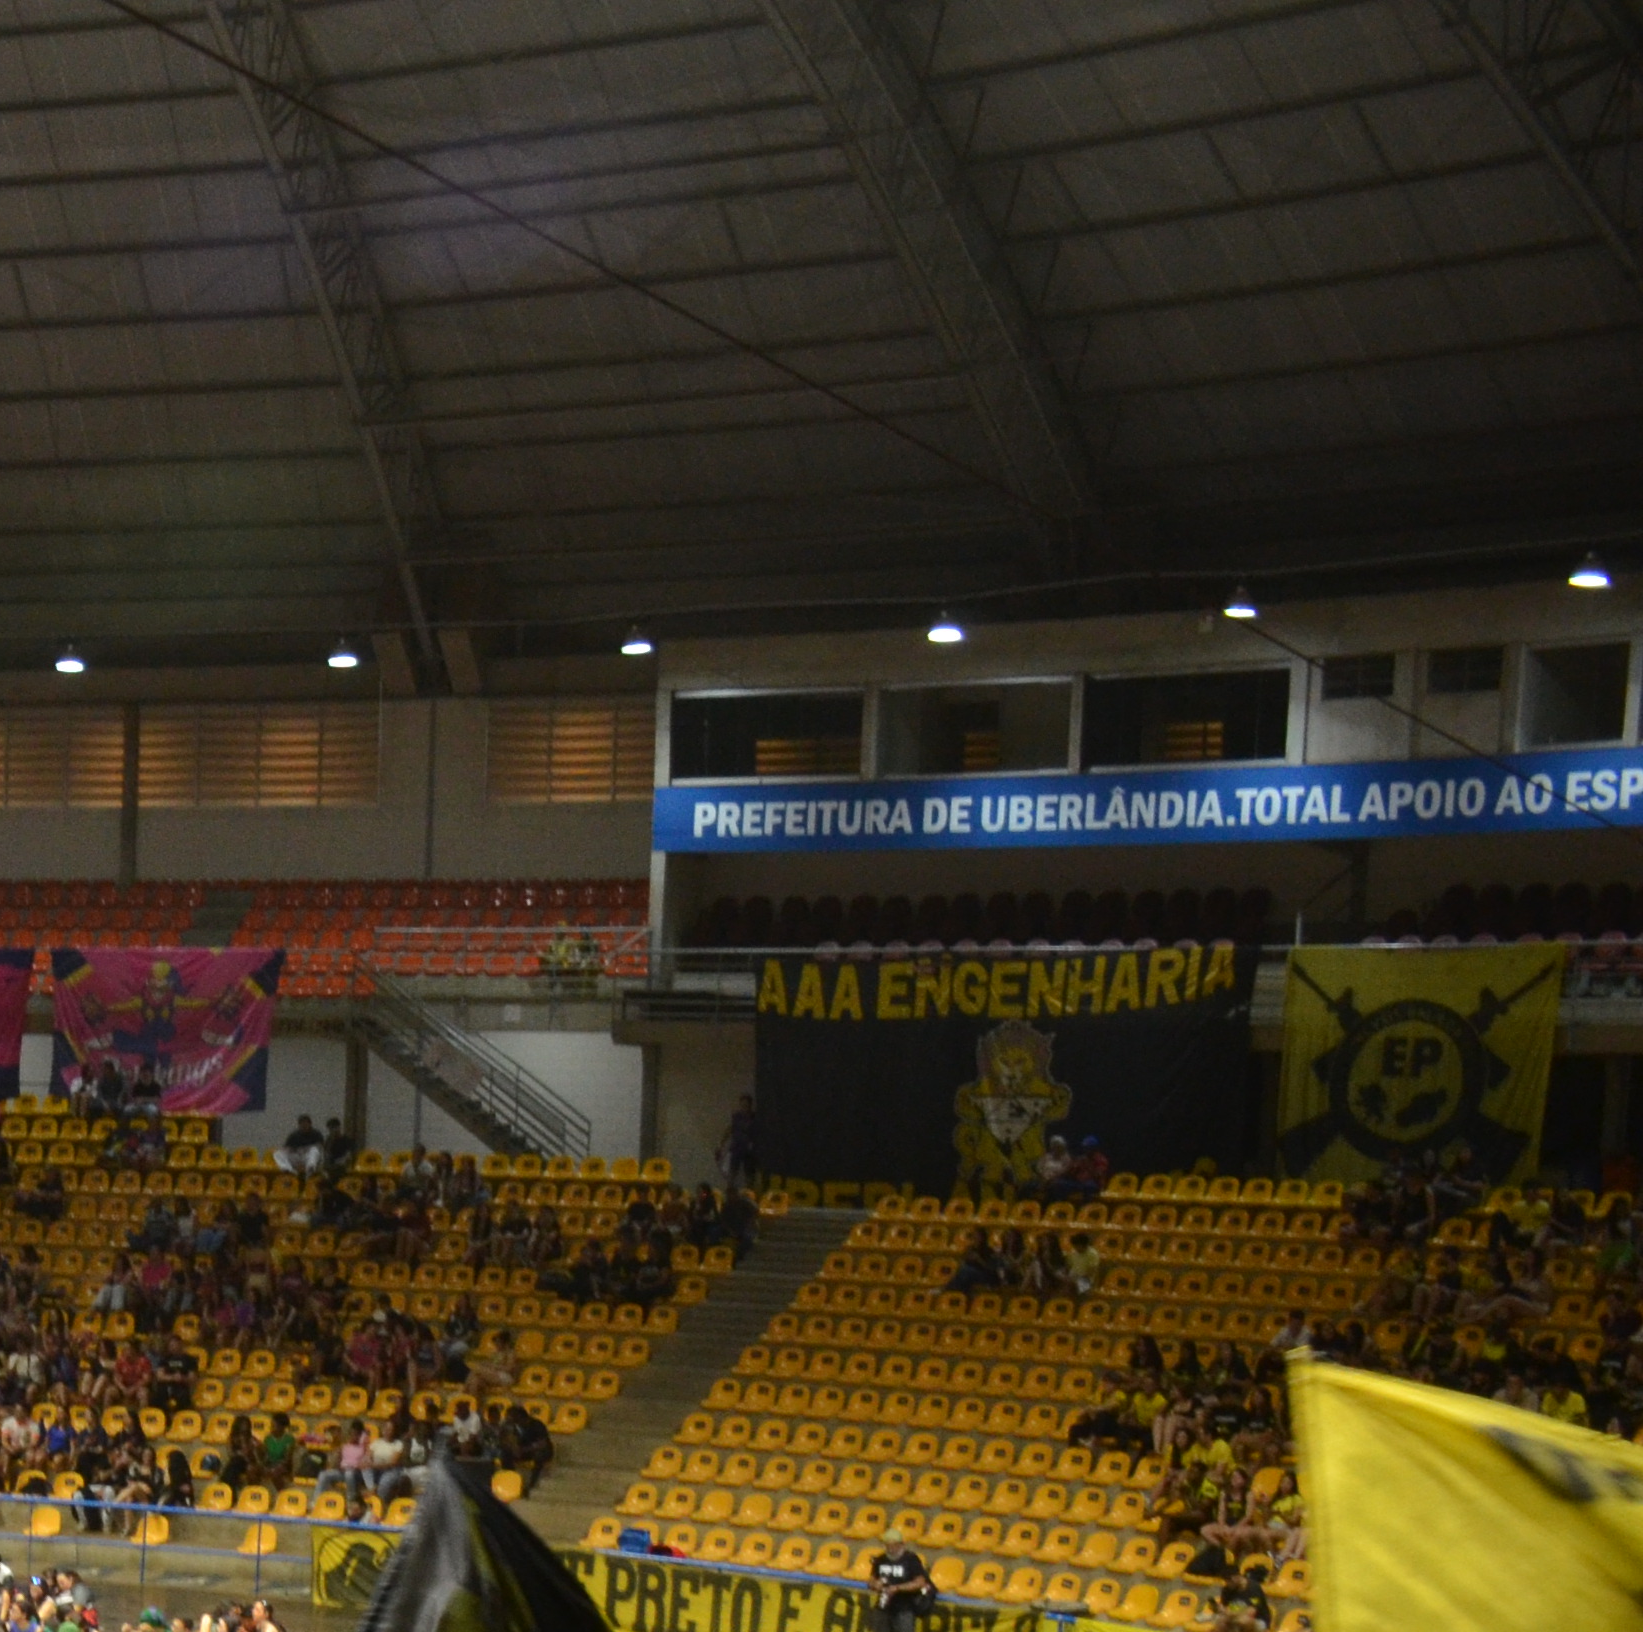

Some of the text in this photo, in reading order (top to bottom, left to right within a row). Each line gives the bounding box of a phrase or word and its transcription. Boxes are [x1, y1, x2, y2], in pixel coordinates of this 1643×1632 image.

[693, 799, 913, 839] PREFEITURA
[922, 796, 971, 834] DE
[1357, 777, 1486, 823] APOIO
[1494, 773, 1554, 816] AO
[1565, 767, 1643, 813] ESP
[756, 943, 1238, 1022] AAA ENGENHARIA
[1382, 1036, 1443, 1077] EP
